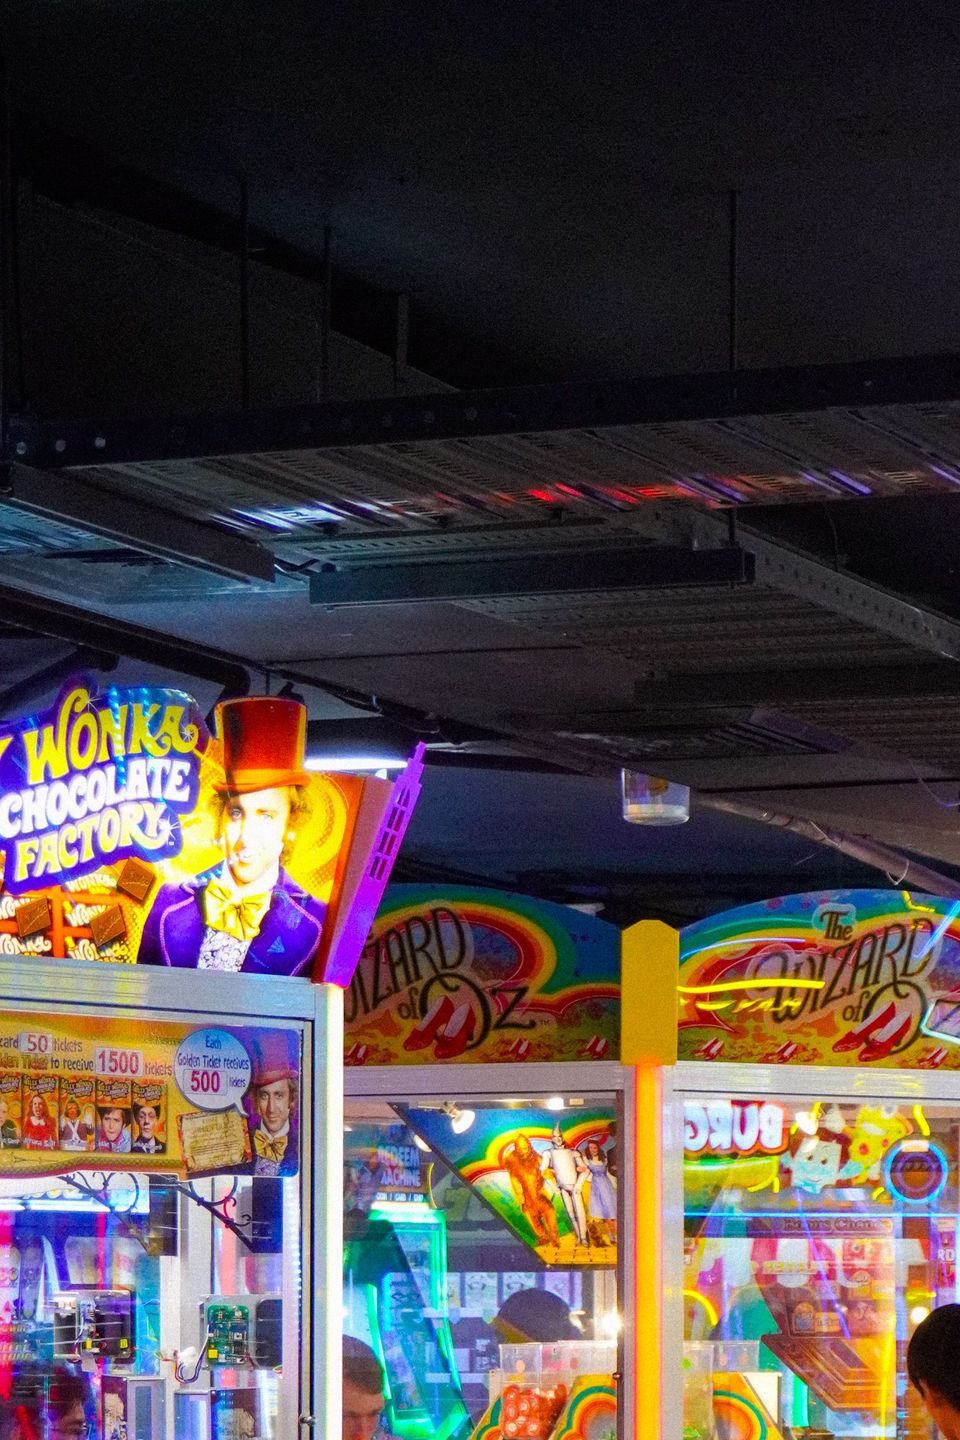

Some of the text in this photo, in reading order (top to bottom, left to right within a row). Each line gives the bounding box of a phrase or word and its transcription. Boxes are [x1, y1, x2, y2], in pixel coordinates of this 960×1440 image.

[23, 688, 199, 785] WONKA
[0, 758, 191, 838] CHOCOLATE
[15, 800, 170, 882] FACTORY
[820, 910, 854, 940] The
[752, 917, 936, 1023] WIZARD
[397, 987, 419, 1019] of
[842, 990, 869, 1022] of
[26, 1034, 49, 1053] 50
[53, 1042, 83, 1052] tickets
[205, 1034, 222, 1050] Each
[50, 1058, 59, 1069] to
[63, 1059, 94, 1071] receive
[98, 1050, 140, 1075] 1500
[144, 1063, 173, 1076] tickets
[202, 1054, 222, 1069] Ticket
[223, 1057, 250, 1070] receives
[190, 1070, 221, 1093] 500
